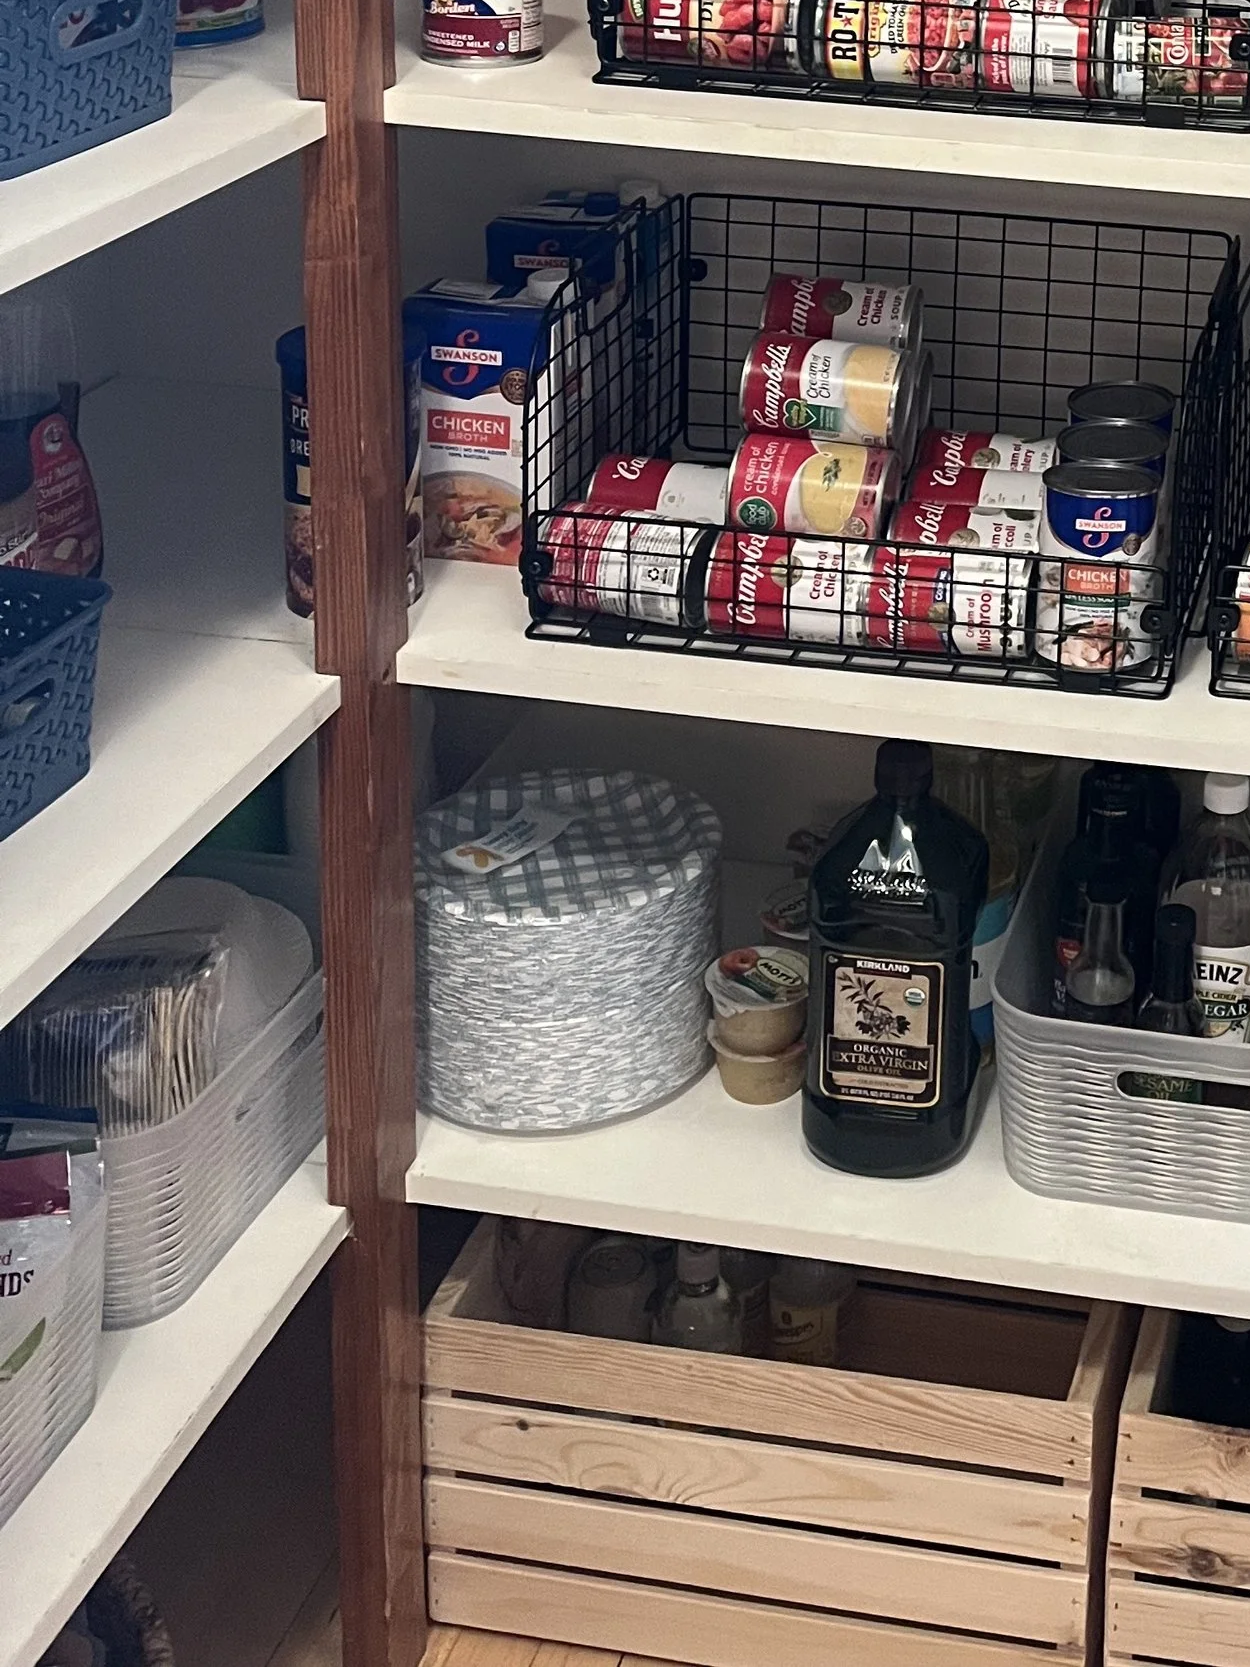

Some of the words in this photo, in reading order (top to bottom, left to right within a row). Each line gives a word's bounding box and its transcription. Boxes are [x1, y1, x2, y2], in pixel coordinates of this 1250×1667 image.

[427, 1, 476, 14] Borden
[857, 295, 873, 327] Cream
[871, 289, 888, 325] Chicken
[435, 348, 499, 363] SWANSON
[806, 361, 820, 399] Cream
[818, 355, 832, 399] Chicken
[431, 415, 505, 435] CHICKEN
[448, 432, 488, 443] BROTH
[751, 446, 761, 457] of
[744, 457, 759, 493] cream
[756, 441, 779, 495] chicken
[1078, 521, 1123, 530] SWANSON
[1068, 568, 1127, 583] CHICKEN
[1080, 581, 1114, 591] BROTH
[856, 960, 911, 973] KIRKLAND
[1195, 962, 1243, 985] EINZ
[1211, 992, 1238, 1002] CIDER
[1204, 1003, 1248, 1017] EGAR
[853, 1043, 908, 1058] ORGANIC
[832, 1050, 877, 1066] EXTRA
[879, 1055, 929, 1071] VIRGIN
[857, 1064, 884, 1075] OLIVE
[886, 1067, 902, 1076] OIL
[1132, 1074, 1194, 1093] SESAME
